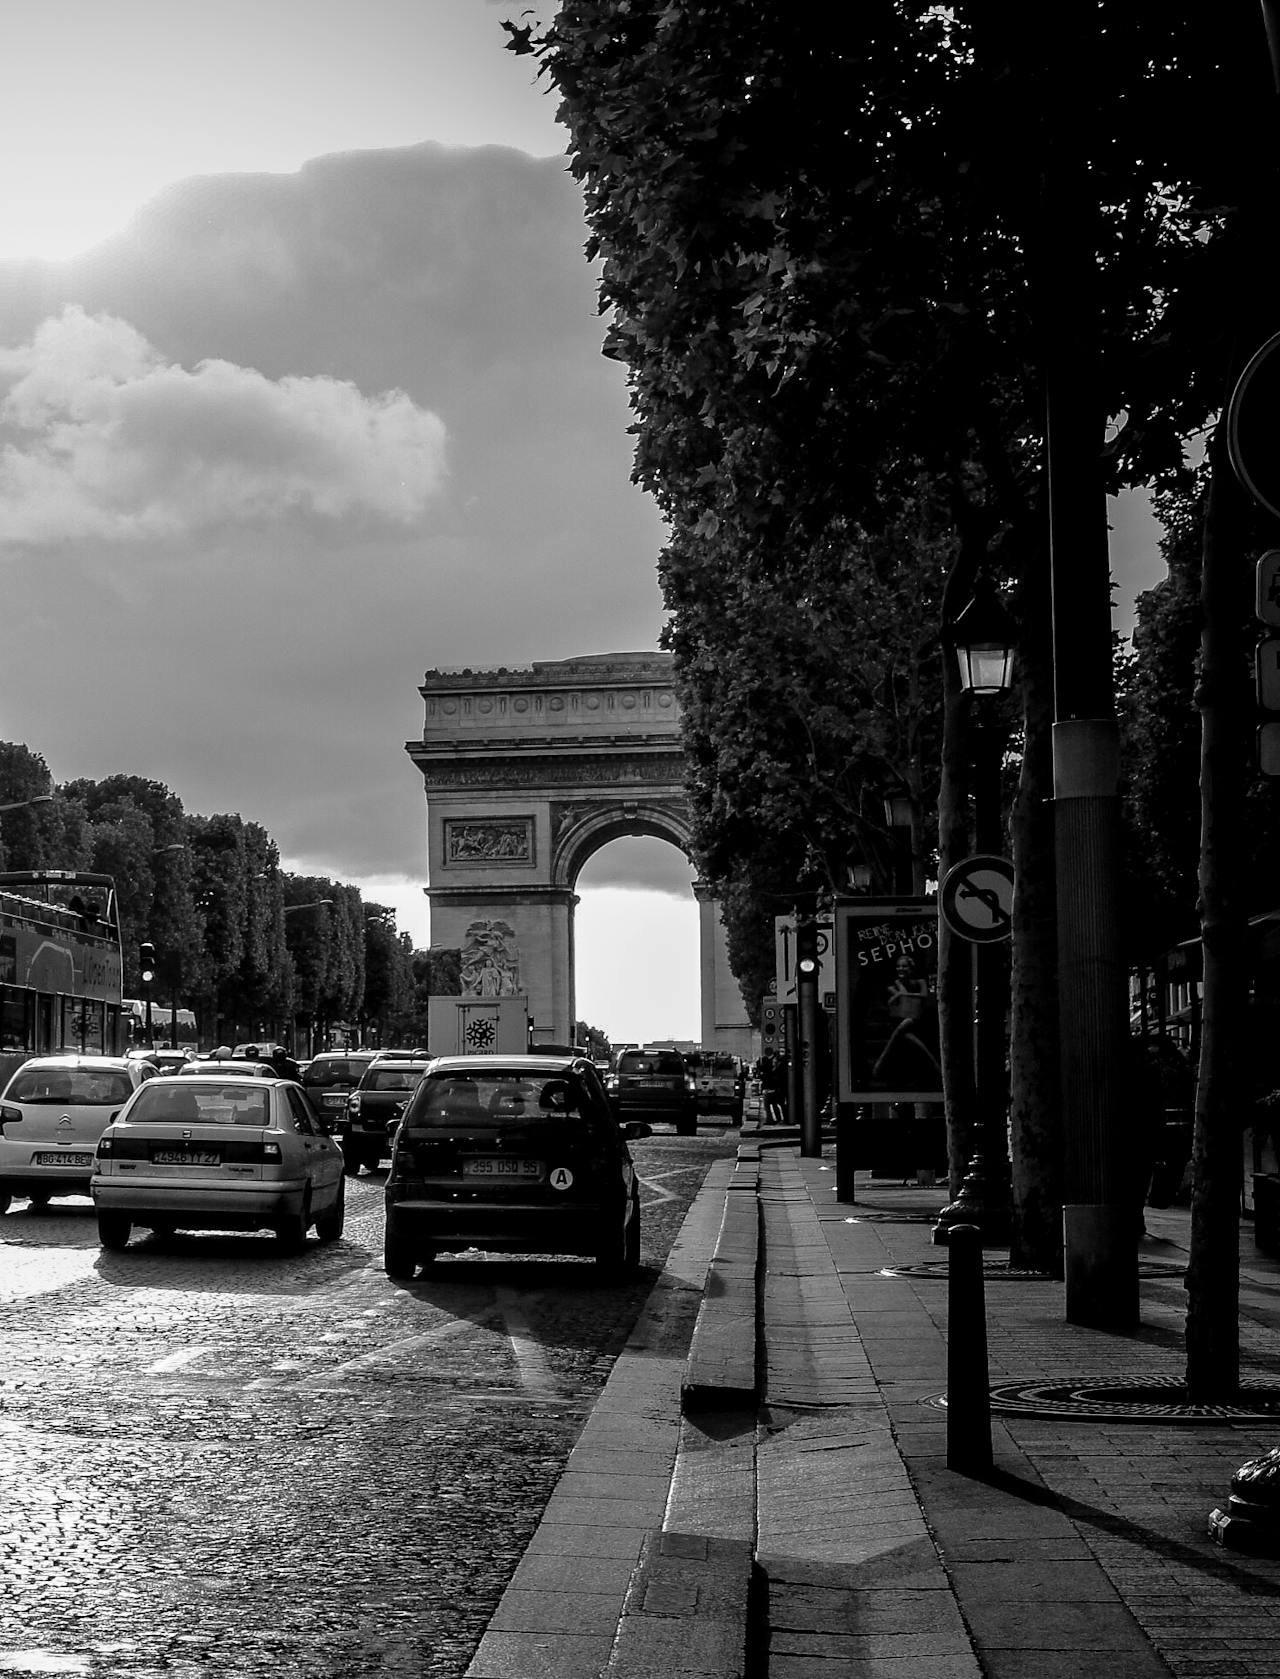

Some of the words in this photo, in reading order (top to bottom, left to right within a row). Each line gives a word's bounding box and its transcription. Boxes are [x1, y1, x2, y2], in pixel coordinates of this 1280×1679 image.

[857, 933, 938, 967] SEPHO
[473, 1160, 493, 1173] 395
[523, 1161, 537, 1173] 95
[556, 1169, 568, 1185] A
